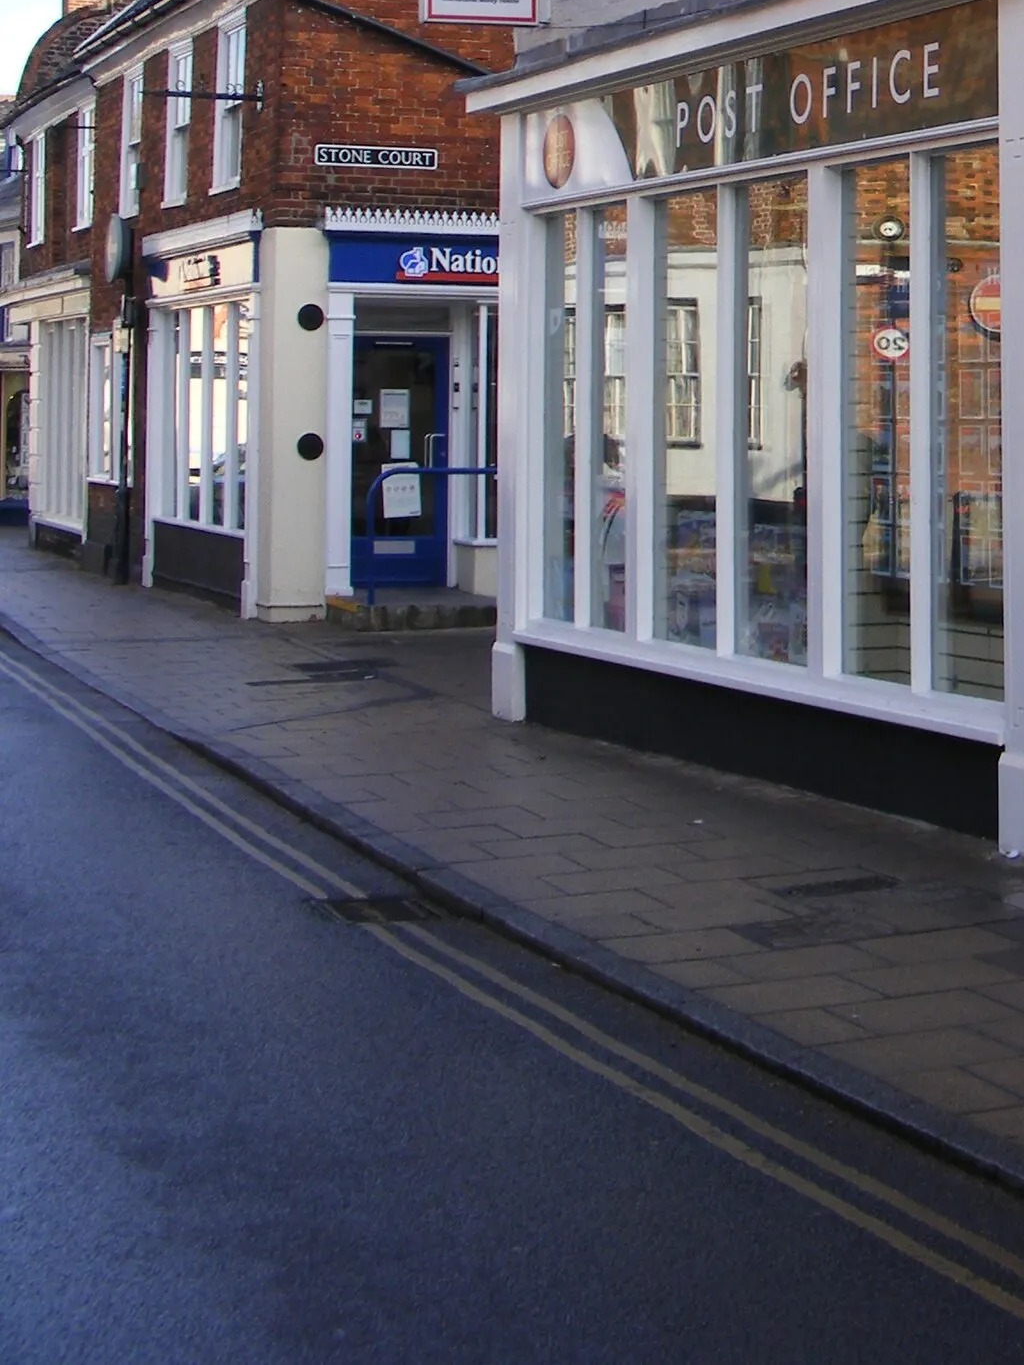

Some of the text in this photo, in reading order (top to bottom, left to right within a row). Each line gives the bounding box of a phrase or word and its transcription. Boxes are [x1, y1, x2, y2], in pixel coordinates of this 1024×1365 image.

[676, 41, 940, 148] POST OFFICE
[319, 148, 433, 166] STONE COURT
[430, 247, 499, 274] Natio
